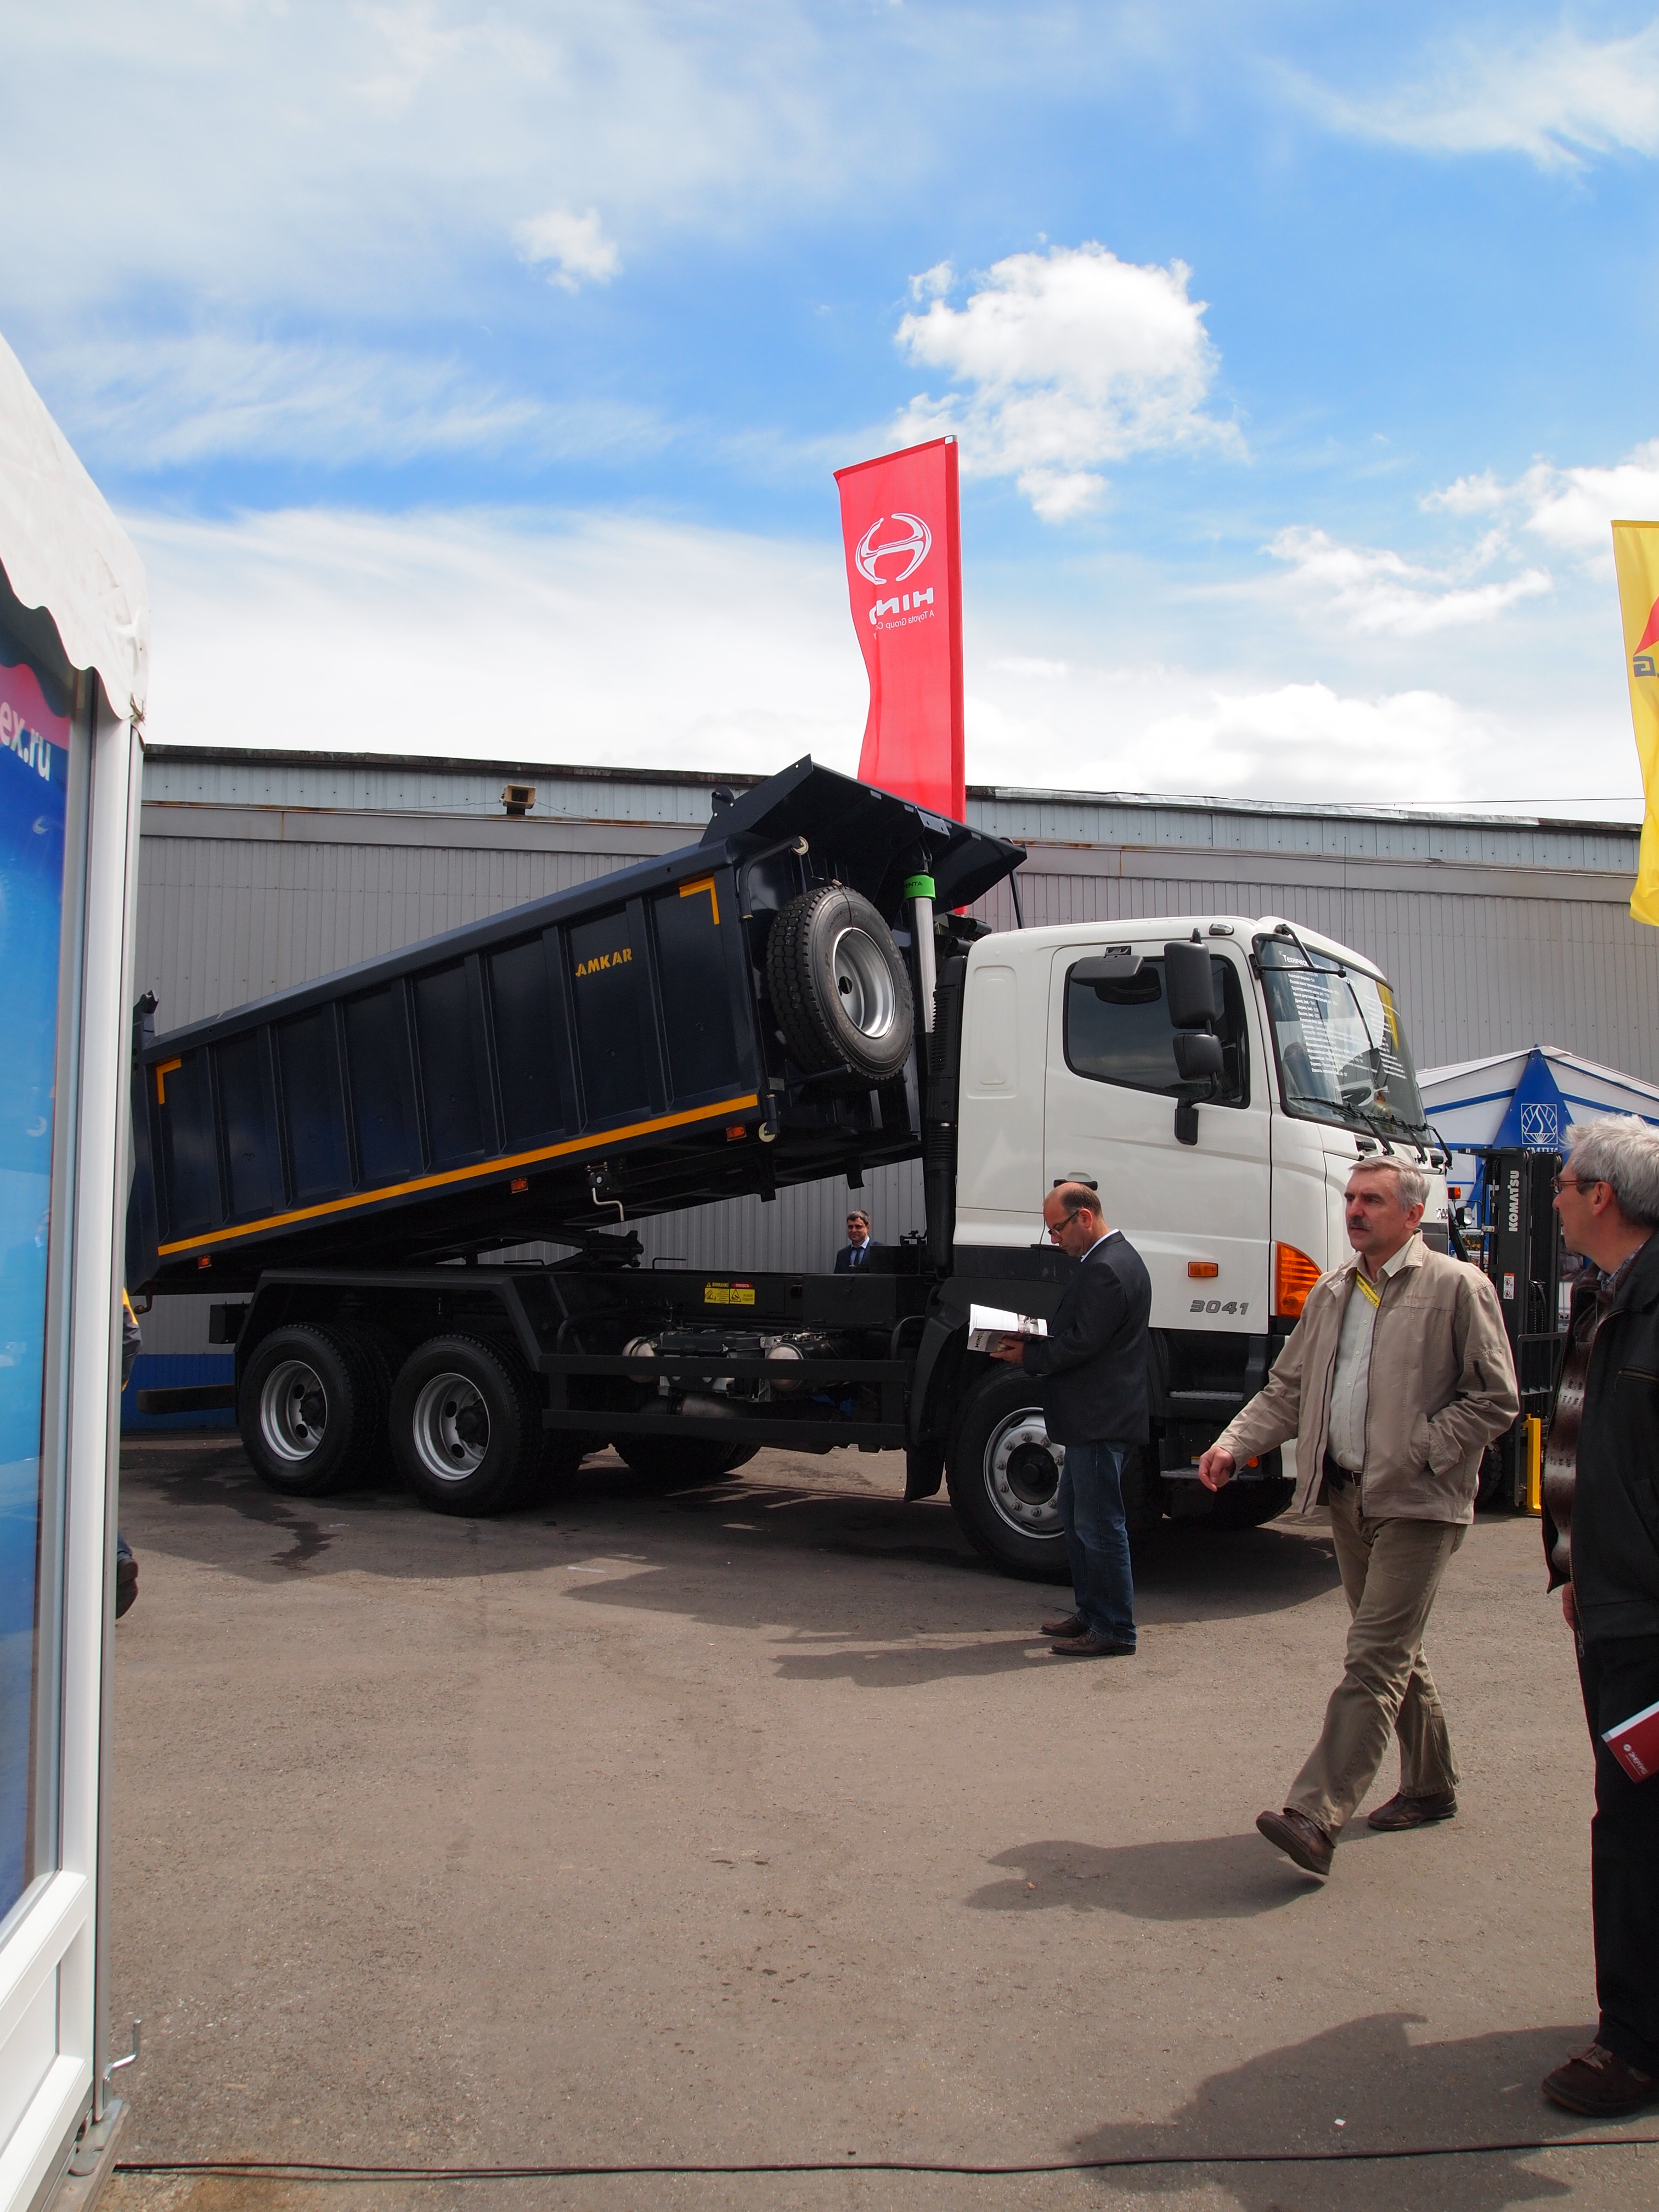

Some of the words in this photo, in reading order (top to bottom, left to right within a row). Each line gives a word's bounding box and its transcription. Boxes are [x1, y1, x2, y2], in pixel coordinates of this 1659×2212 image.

[575, 948, 633, 977] AMKAR
[1507, 1170, 1519, 1232] KOMATSU
[1189, 1300, 1249, 1315] 3041
